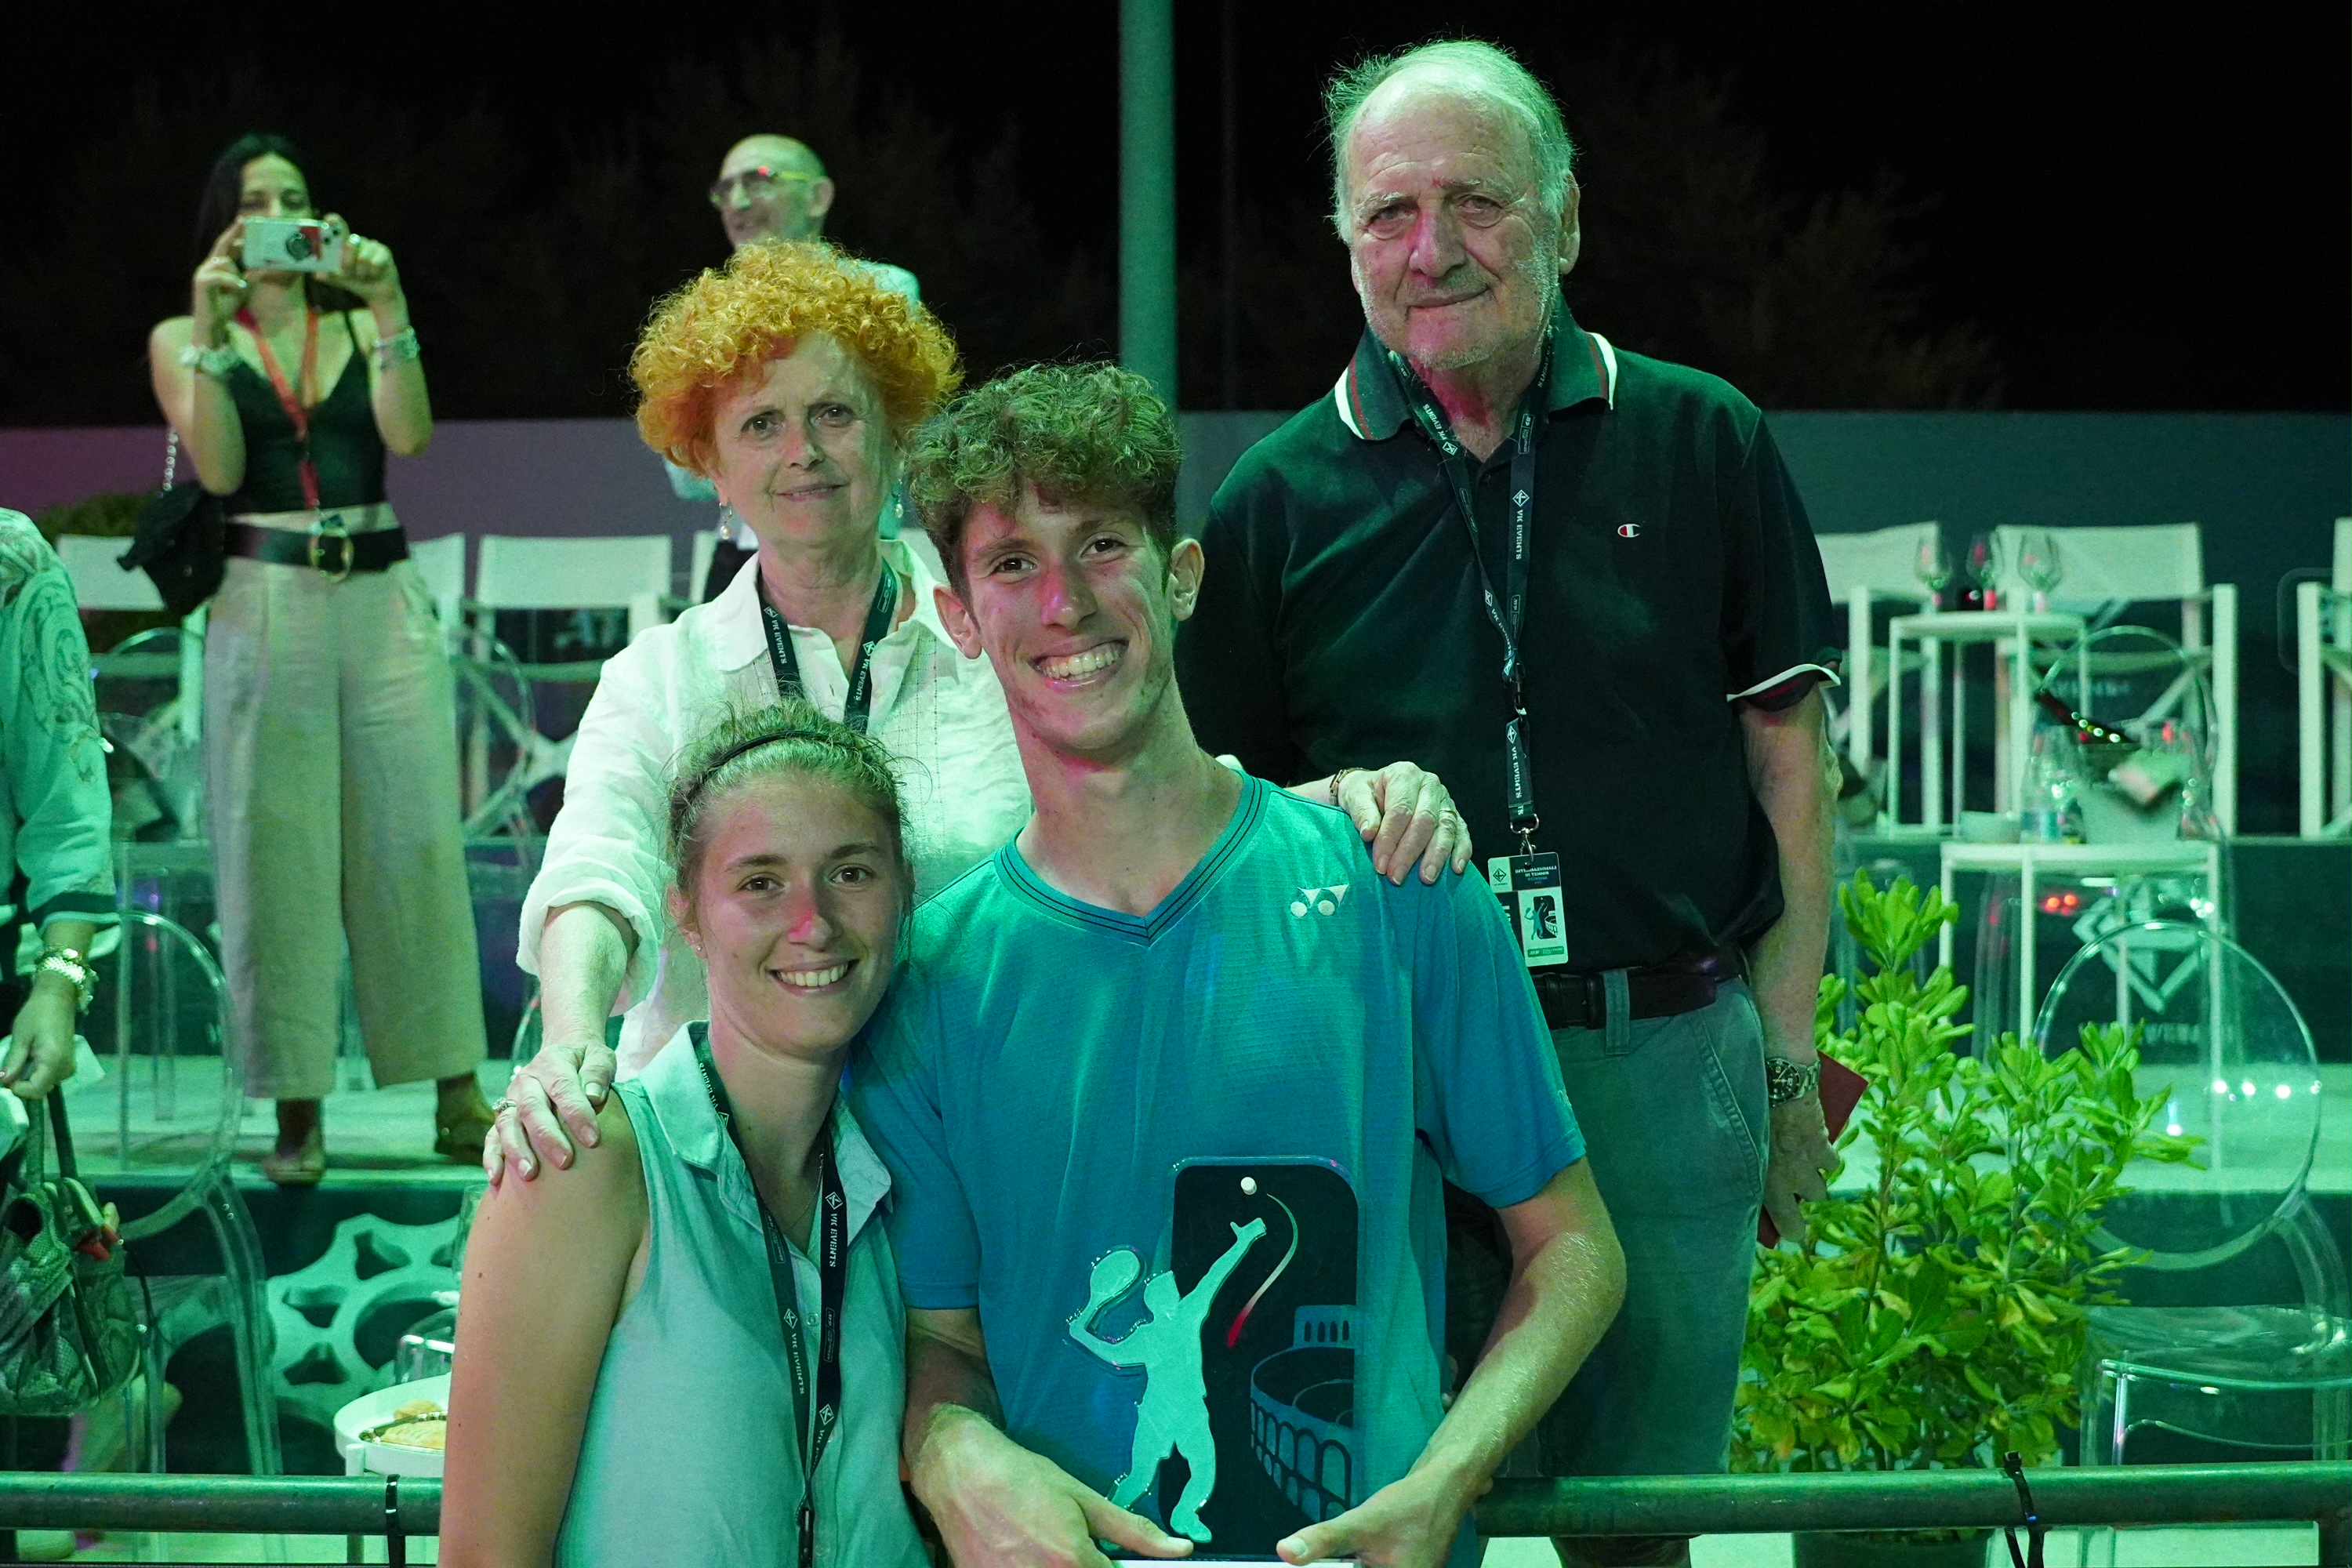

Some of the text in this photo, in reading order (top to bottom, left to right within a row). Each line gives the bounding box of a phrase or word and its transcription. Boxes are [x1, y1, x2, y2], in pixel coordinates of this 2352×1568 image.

[1423, 404, 1443, 430] EVENTS
[1516, 509, 1523, 522] VK
[1491, 608, 1499, 622] VK
[771, 619, 787, 664] VK EVENTS
[855, 659, 869, 701] VK EVENTS
[1512, 746, 1518, 760] VK
[1513, 762, 1522, 799] EVENTS
[829, 1213, 838, 1268] VK EVENTS
[792, 1333, 804, 1394] VK EVENTS
